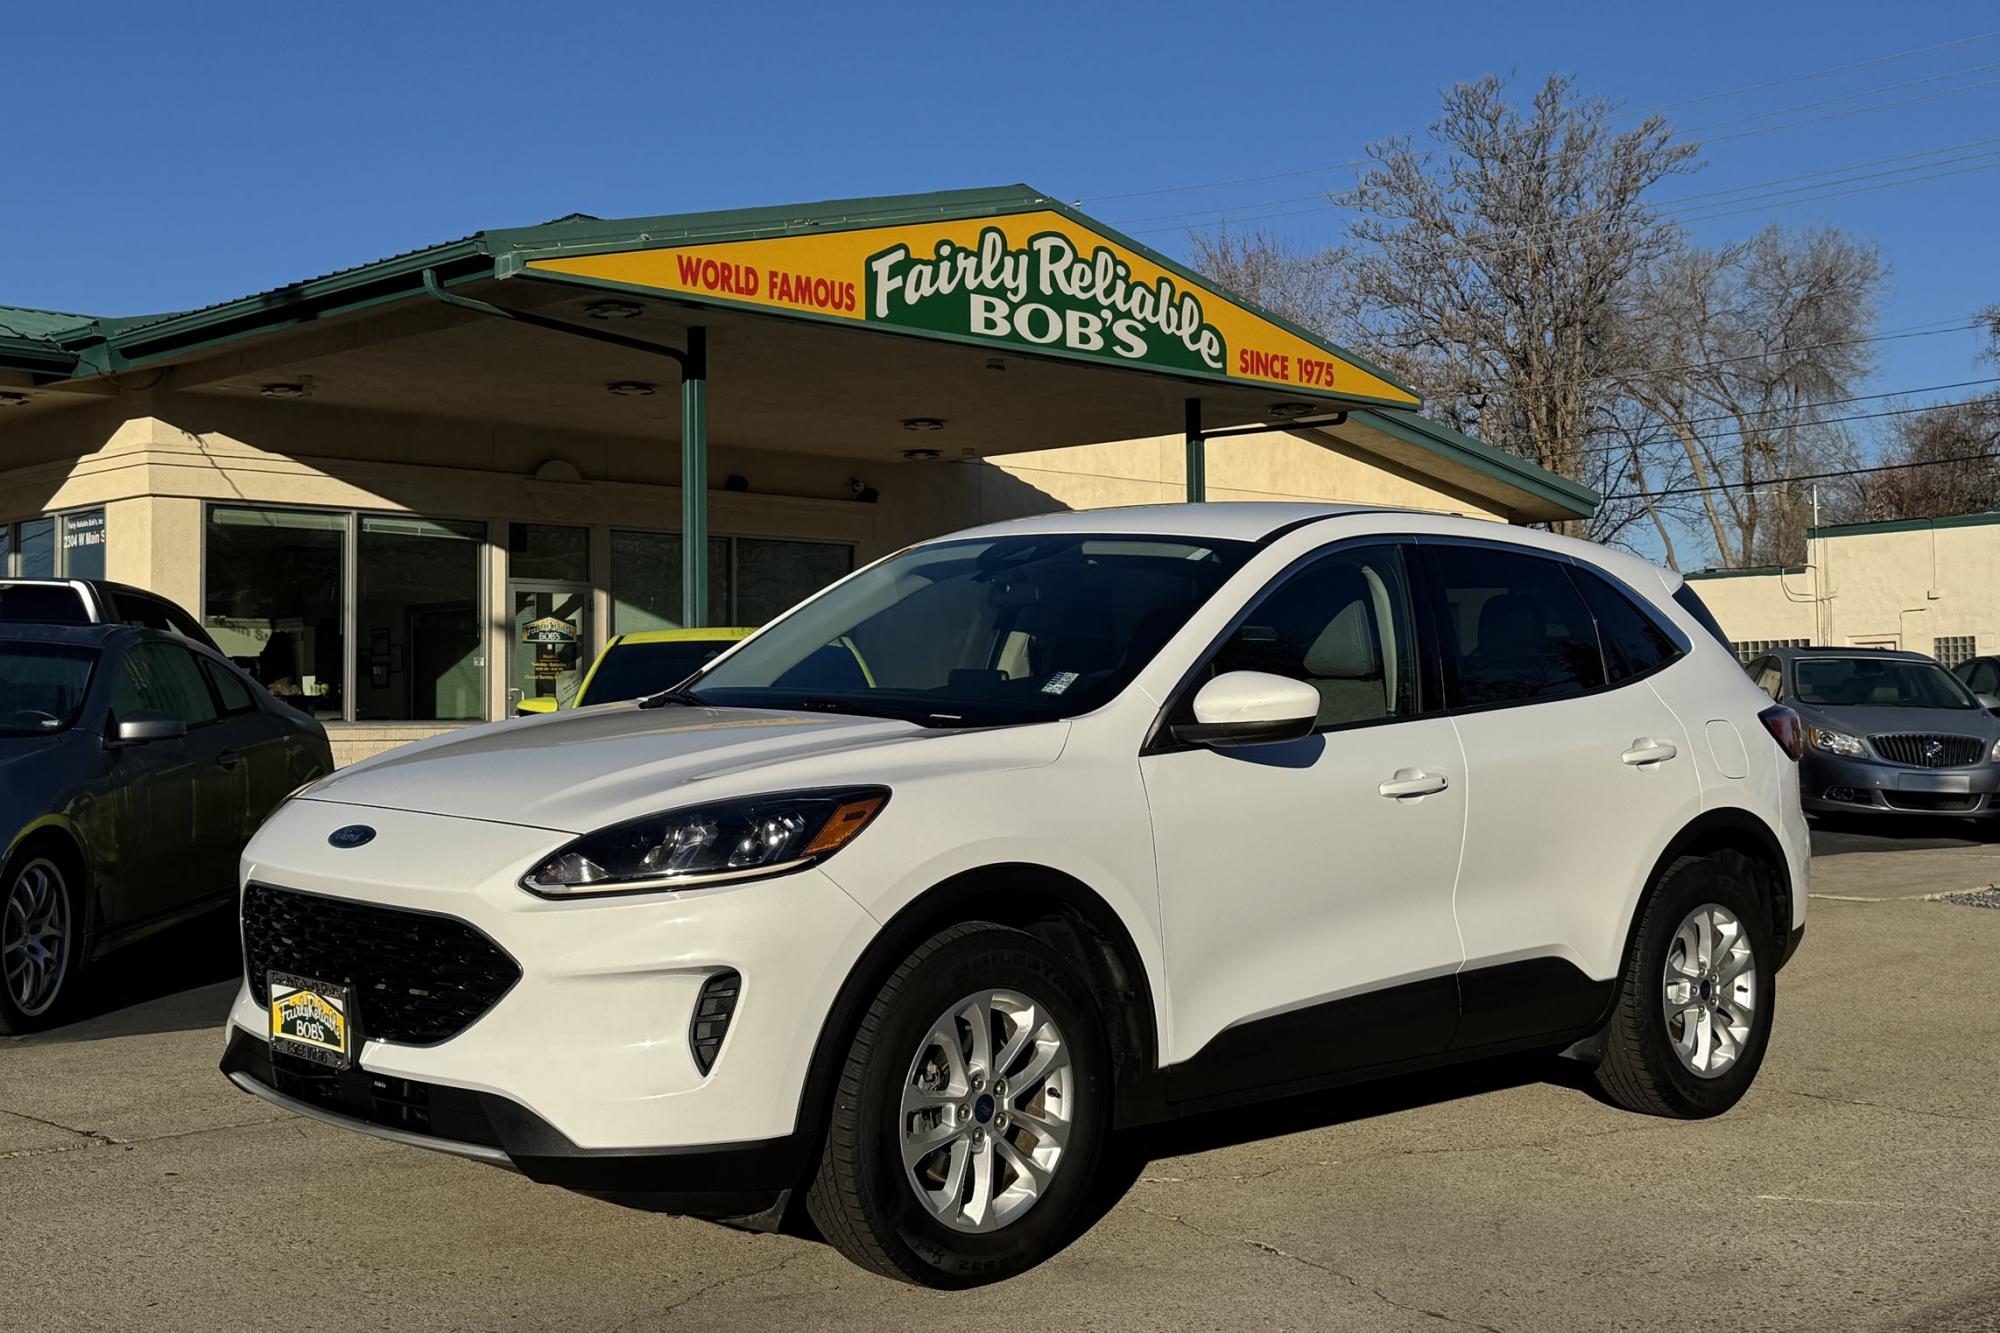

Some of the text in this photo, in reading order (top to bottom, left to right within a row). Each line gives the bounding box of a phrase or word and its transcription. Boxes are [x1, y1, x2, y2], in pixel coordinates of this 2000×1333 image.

[677, 254, 856, 312] WORLD FAMOUS
[871, 231, 1223, 368] Fairly Reliable
[970, 293, 1148, 358] BOB'S
[1239, 348, 1335, 387] SINCE 1975
[64, 535, 77, 549] 2304
[78, 533, 84, 545] W
[85, 531, 99, 544] Main
[279, 997, 309, 1024] Fairly
[296, 1020, 325, 1042] BOB'S
